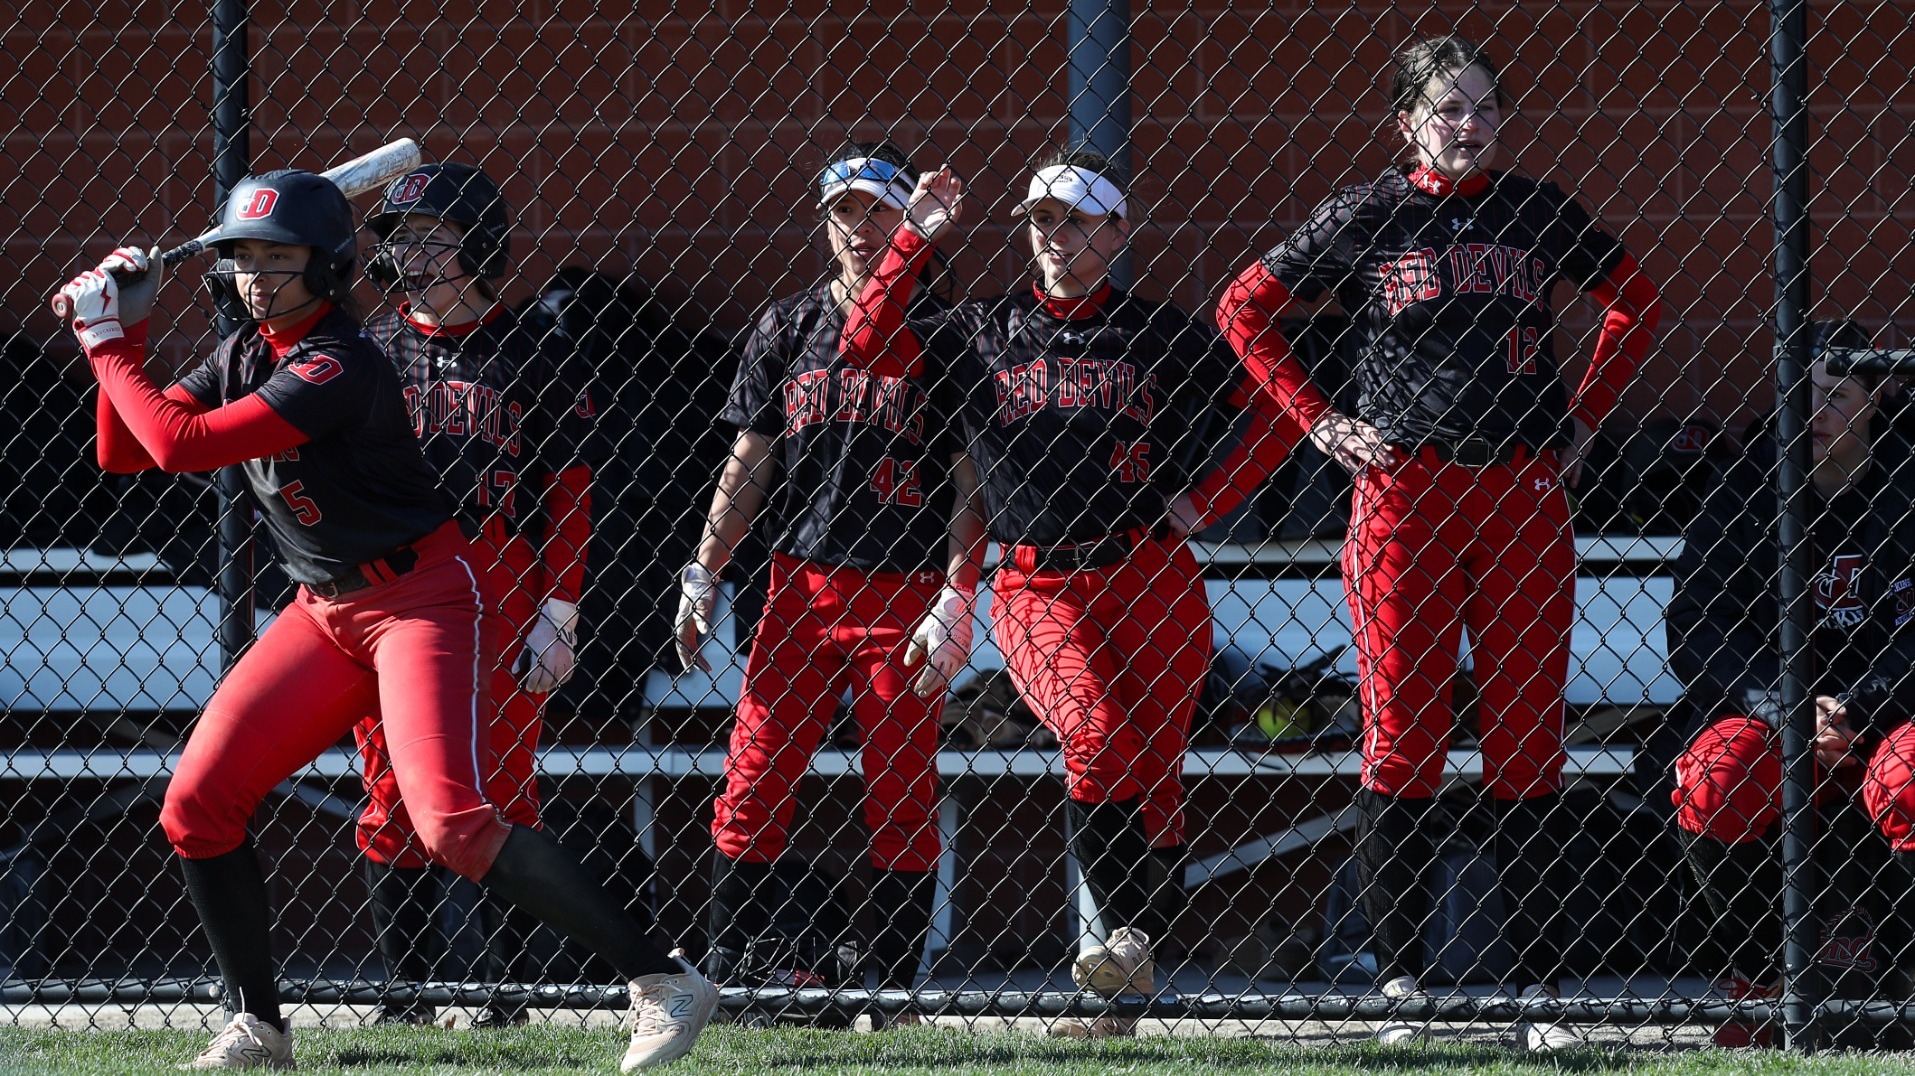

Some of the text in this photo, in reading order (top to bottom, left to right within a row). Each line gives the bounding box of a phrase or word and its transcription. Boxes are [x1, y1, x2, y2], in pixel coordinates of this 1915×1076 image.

[1378, 243, 1545, 317] RED DEVILS
[1506, 326, 1538, 375] 12
[429, 380, 522, 458] DEVILS
[783, 368, 830, 439] RED
[993, 356, 1157, 430] RED DEVILS
[870, 456, 921, 508] 42
[1108, 440, 1151, 483] 45
[279, 479, 322, 527] 5
[475, 469, 517, 518] 17
